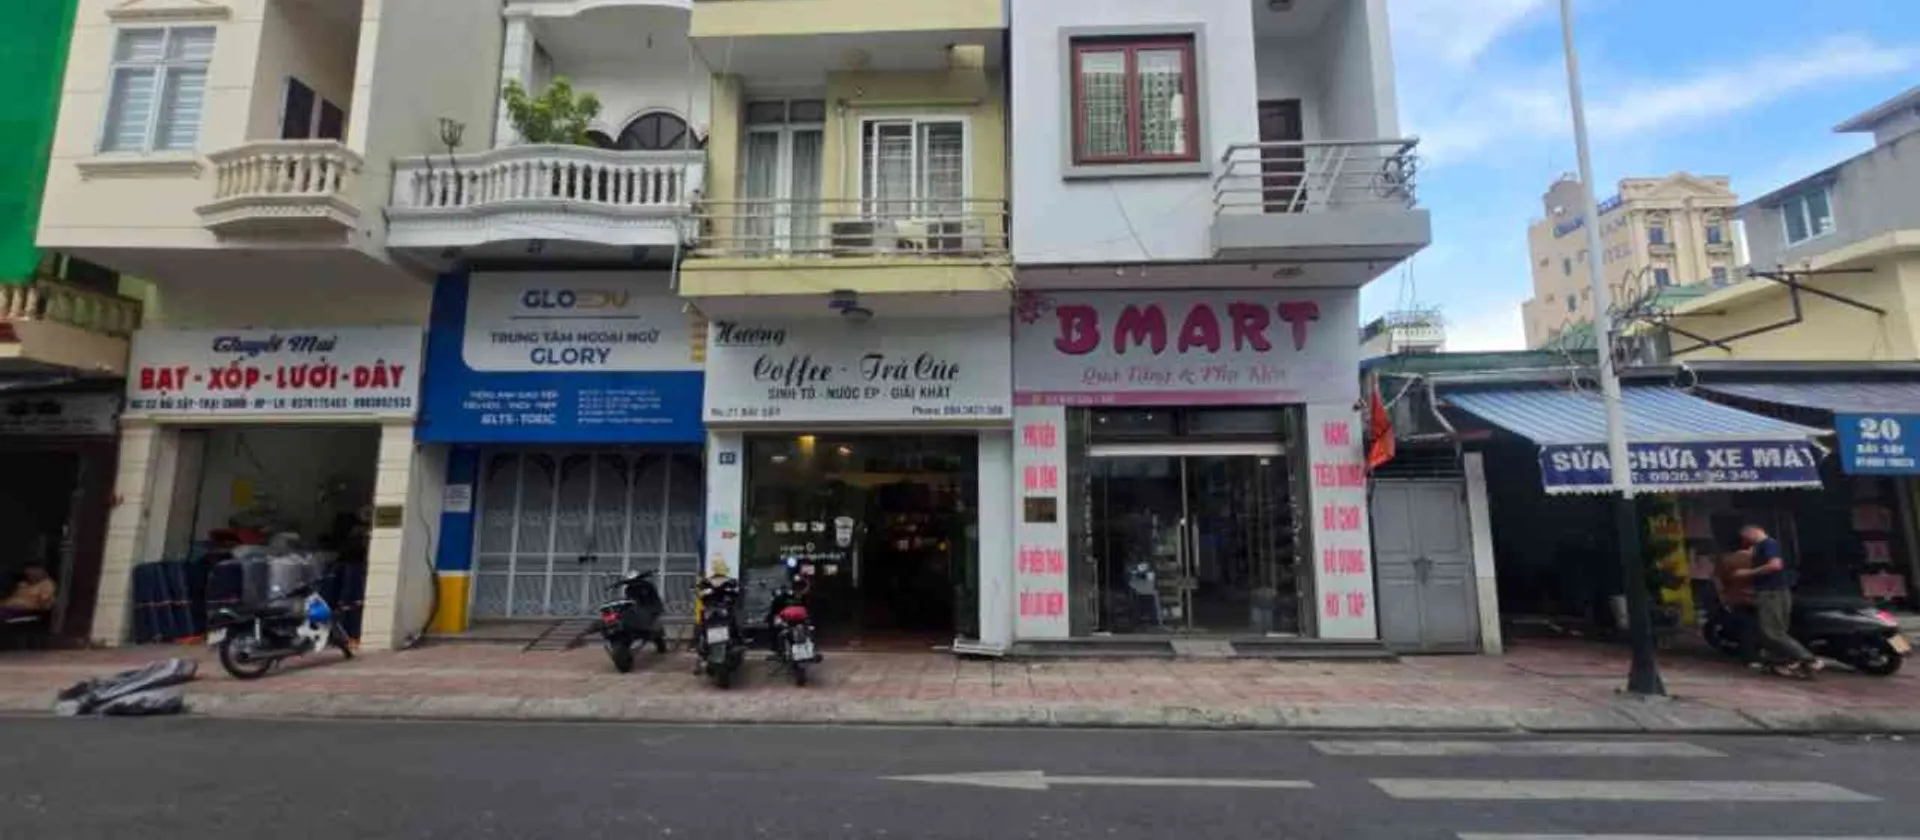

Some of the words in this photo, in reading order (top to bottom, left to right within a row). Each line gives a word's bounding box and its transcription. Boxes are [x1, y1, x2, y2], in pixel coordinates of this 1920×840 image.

[491, 331, 539, 344] TRUNG
[544, 329, 574, 343] TÂM
[1054, 301, 1320, 355] BMART
[531, 348, 611, 365] GLORY
[140, 366, 189, 396] BẠT
[207, 356, 260, 391] XỐP
[353, 357, 404, 388] DÂY
[754, 354, 832, 386] Coffee
[861, 352, 909, 381] Trà
[768, 387, 796, 400] SINH
[1860, 418, 1901, 440] 20
[1552, 445, 1611, 472] SỬA
[1706, 447, 1744, 468] XE
